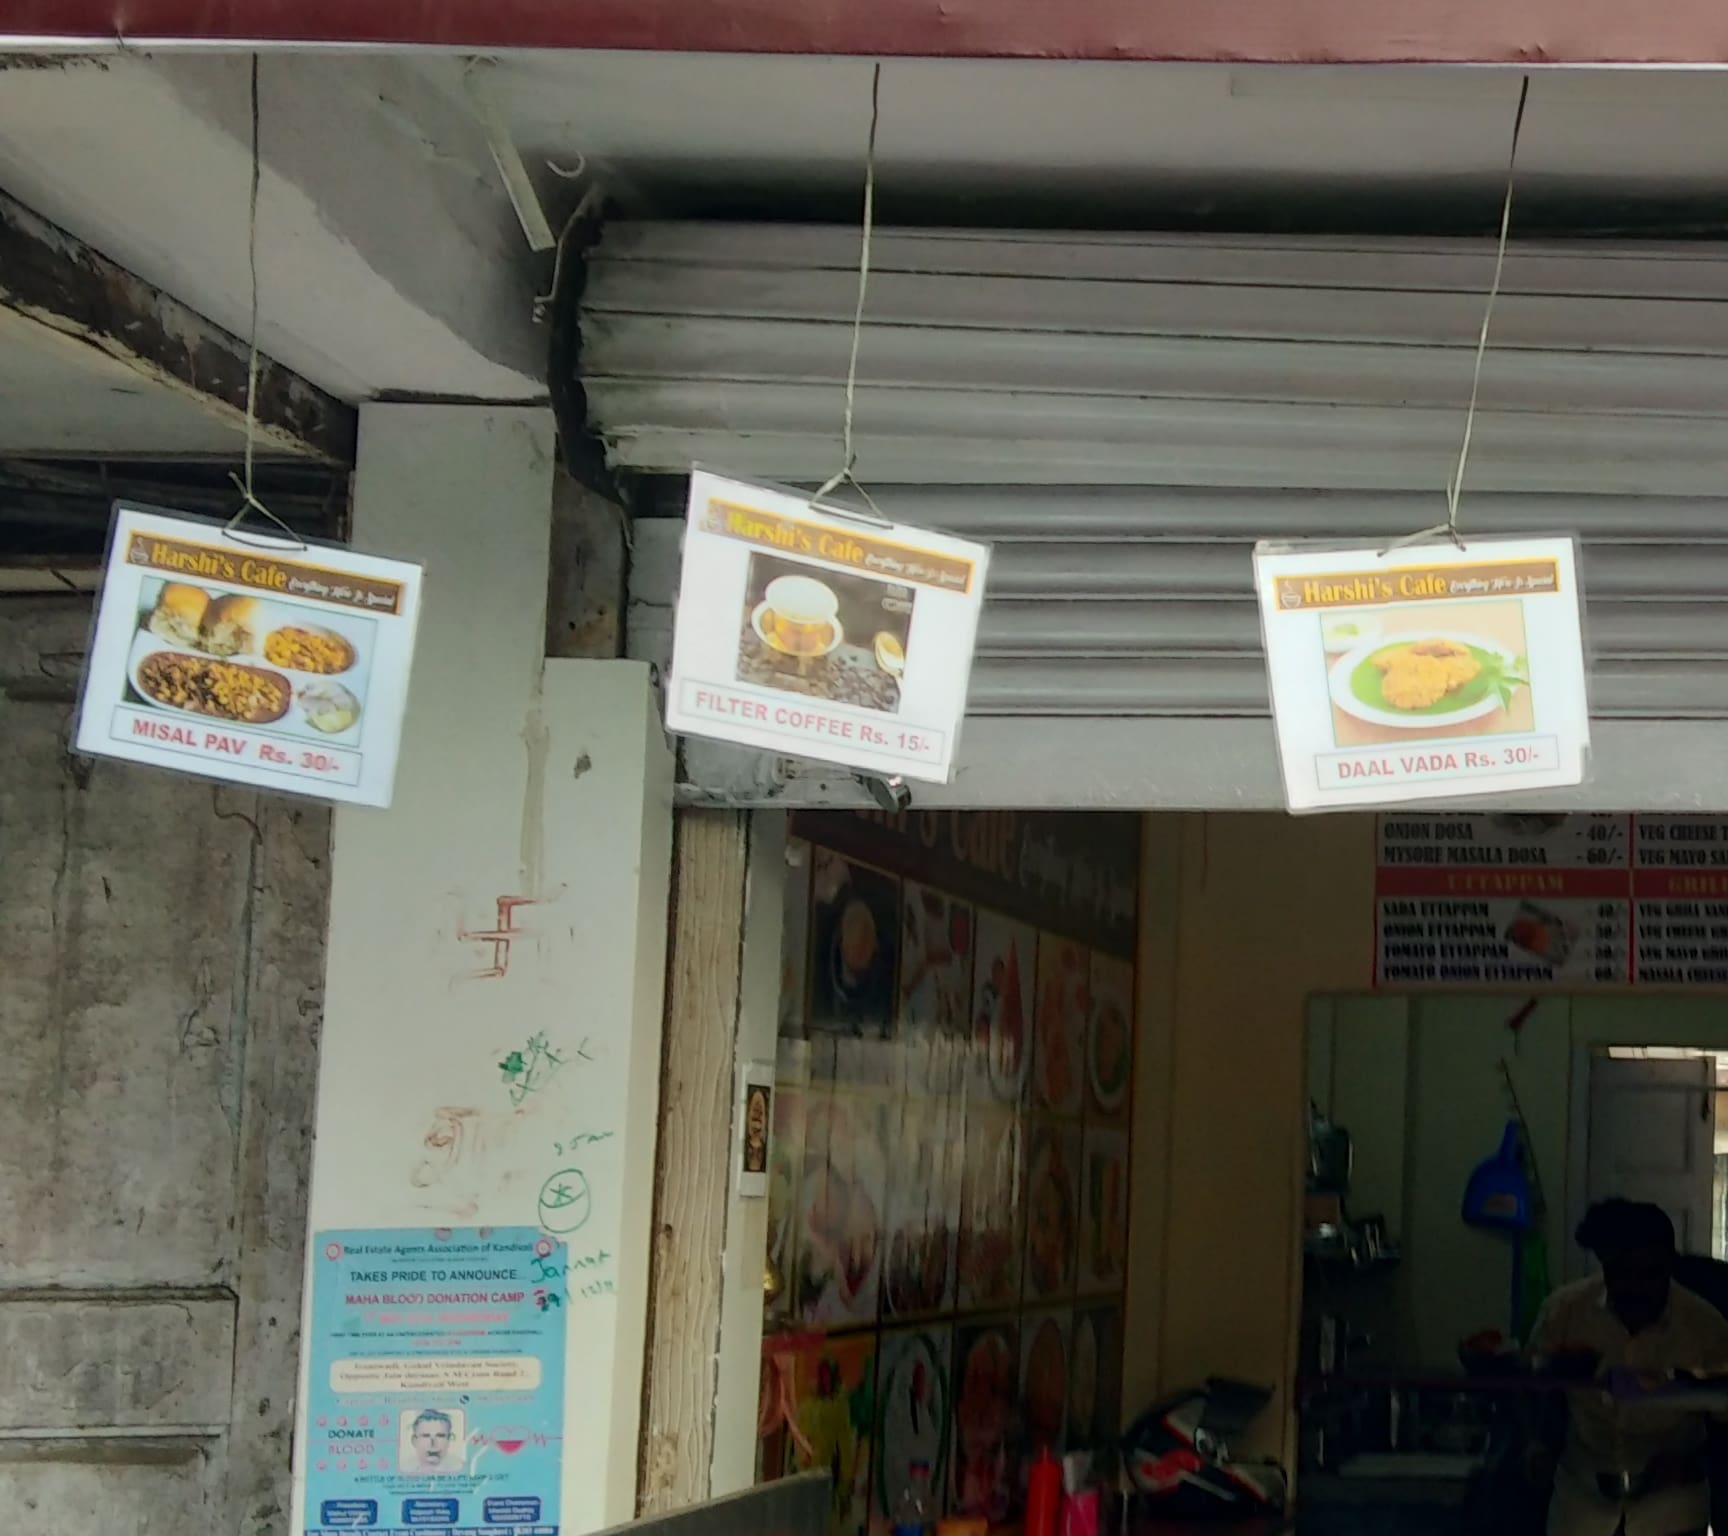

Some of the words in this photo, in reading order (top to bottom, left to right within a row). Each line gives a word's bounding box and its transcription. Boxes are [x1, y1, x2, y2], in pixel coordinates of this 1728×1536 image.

[727, 510, 812, 554] Harshi's
[818, 533, 864, 565] Cafe
[150, 541, 237, 580] Harshi's
[240, 559, 288, 590] Cafe
[1302, 575, 1393, 605] Harshi's
[1400, 572, 1448, 598] Cafe
[696, 690, 768, 721] FILTER
[774, 707, 853, 739] COFFEE
[859, 725, 889, 746] Rs.
[897, 734, 930, 752] 15/-
[132, 718, 198, 748] MISAL
[204, 732, 247, 756] PAV
[258, 744, 293, 766] Rs.
[1337, 760, 1395, 780] DAAL
[1400, 753, 1459, 774] VADA
[1464, 750, 1497, 768] Rs.
[1384, 823, 1430, 840] ONION
[1435, 823, 1473, 840] DOSA
[1639, 825, 1665, 841] VEG
[1669, 825, 1717, 841] CHEESE
[1447, 847, 1503, 864] MASALA
[1509, 848, 1547, 864] DOSA
[1639, 849, 1665, 865] VEG
[1669, 849, 1705, 865] MAYO
[427, 1243, 479, 1254] Association
[350, 1270, 387, 1282] TAKES
[392, 1270, 427, 1282] PRIDE
[432, 1270, 446, 1282] TO
[346, 1294, 380, 1305] MAHA
[382, 1293, 424, 1305] BLOOD
[426, 1292, 488, 1304] DONATION
[491, 1291, 525, 1304] CAMP
[328, 1429, 375, 1439] DONATE
[328, 1444, 375, 1455] BLOOD
